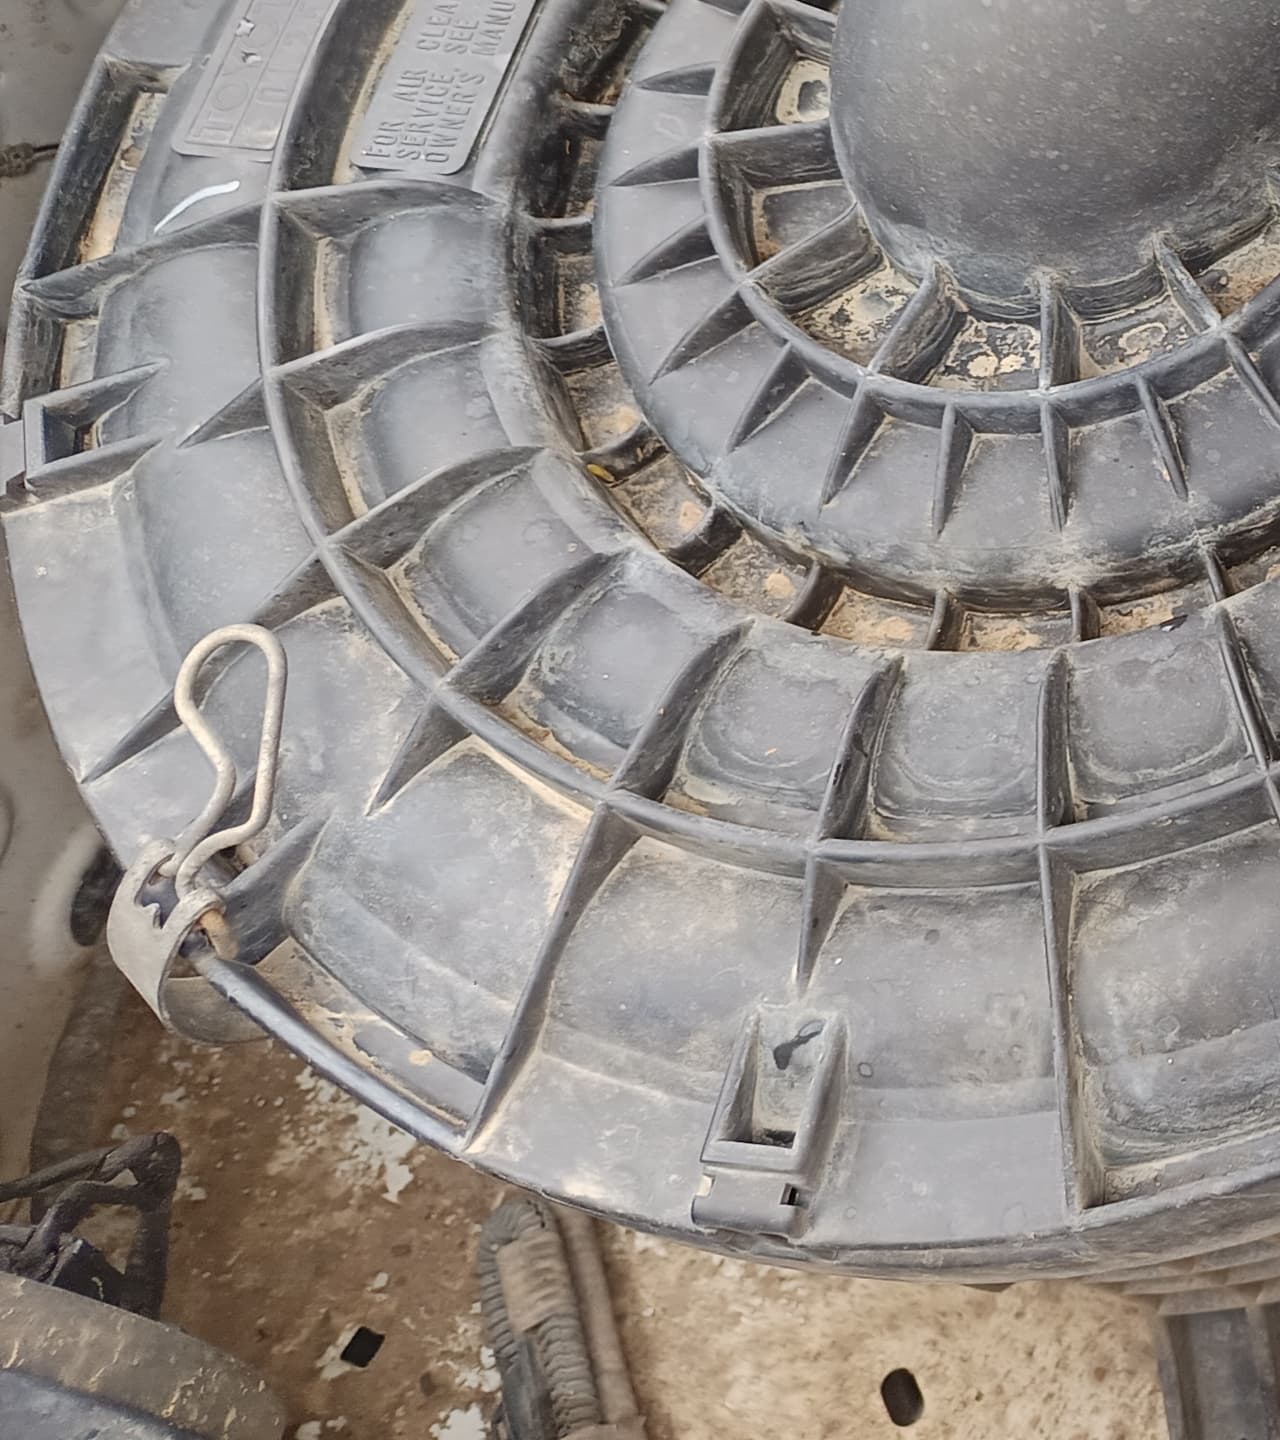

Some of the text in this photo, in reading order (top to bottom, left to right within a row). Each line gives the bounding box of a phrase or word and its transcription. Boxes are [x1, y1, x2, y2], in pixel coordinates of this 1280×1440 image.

[443, 18, 481, 57] SEE
[365, 119, 405, 159] FOR
[395, 68, 429, 104] AIR
[424, 70, 487, 164] OWNER'S
